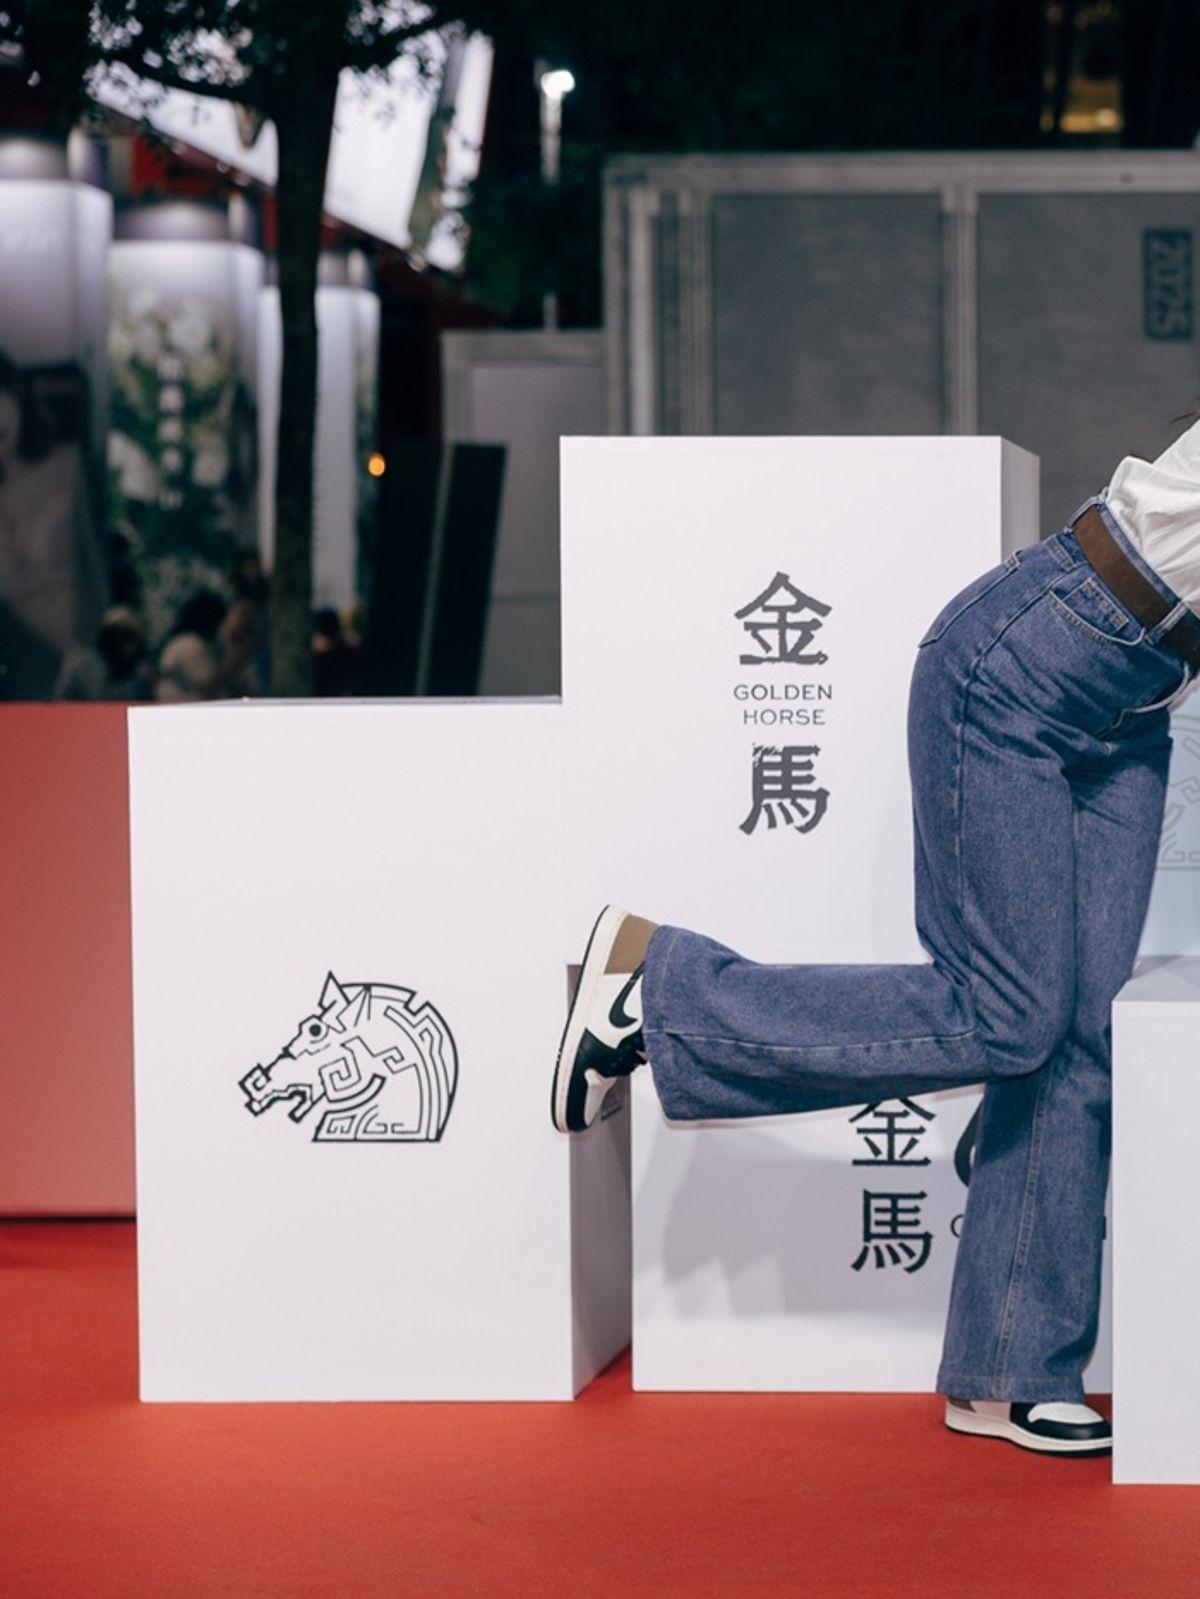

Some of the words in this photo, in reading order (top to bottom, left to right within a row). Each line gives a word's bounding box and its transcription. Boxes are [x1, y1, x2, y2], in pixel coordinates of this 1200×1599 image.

[1149, 236, 1189, 335] 2025
[734, 571, 832, 665] 金
[733, 684, 832, 701] GOLDEN
[743, 709, 826, 725] HORSE
[739, 743, 830, 835] 馬
